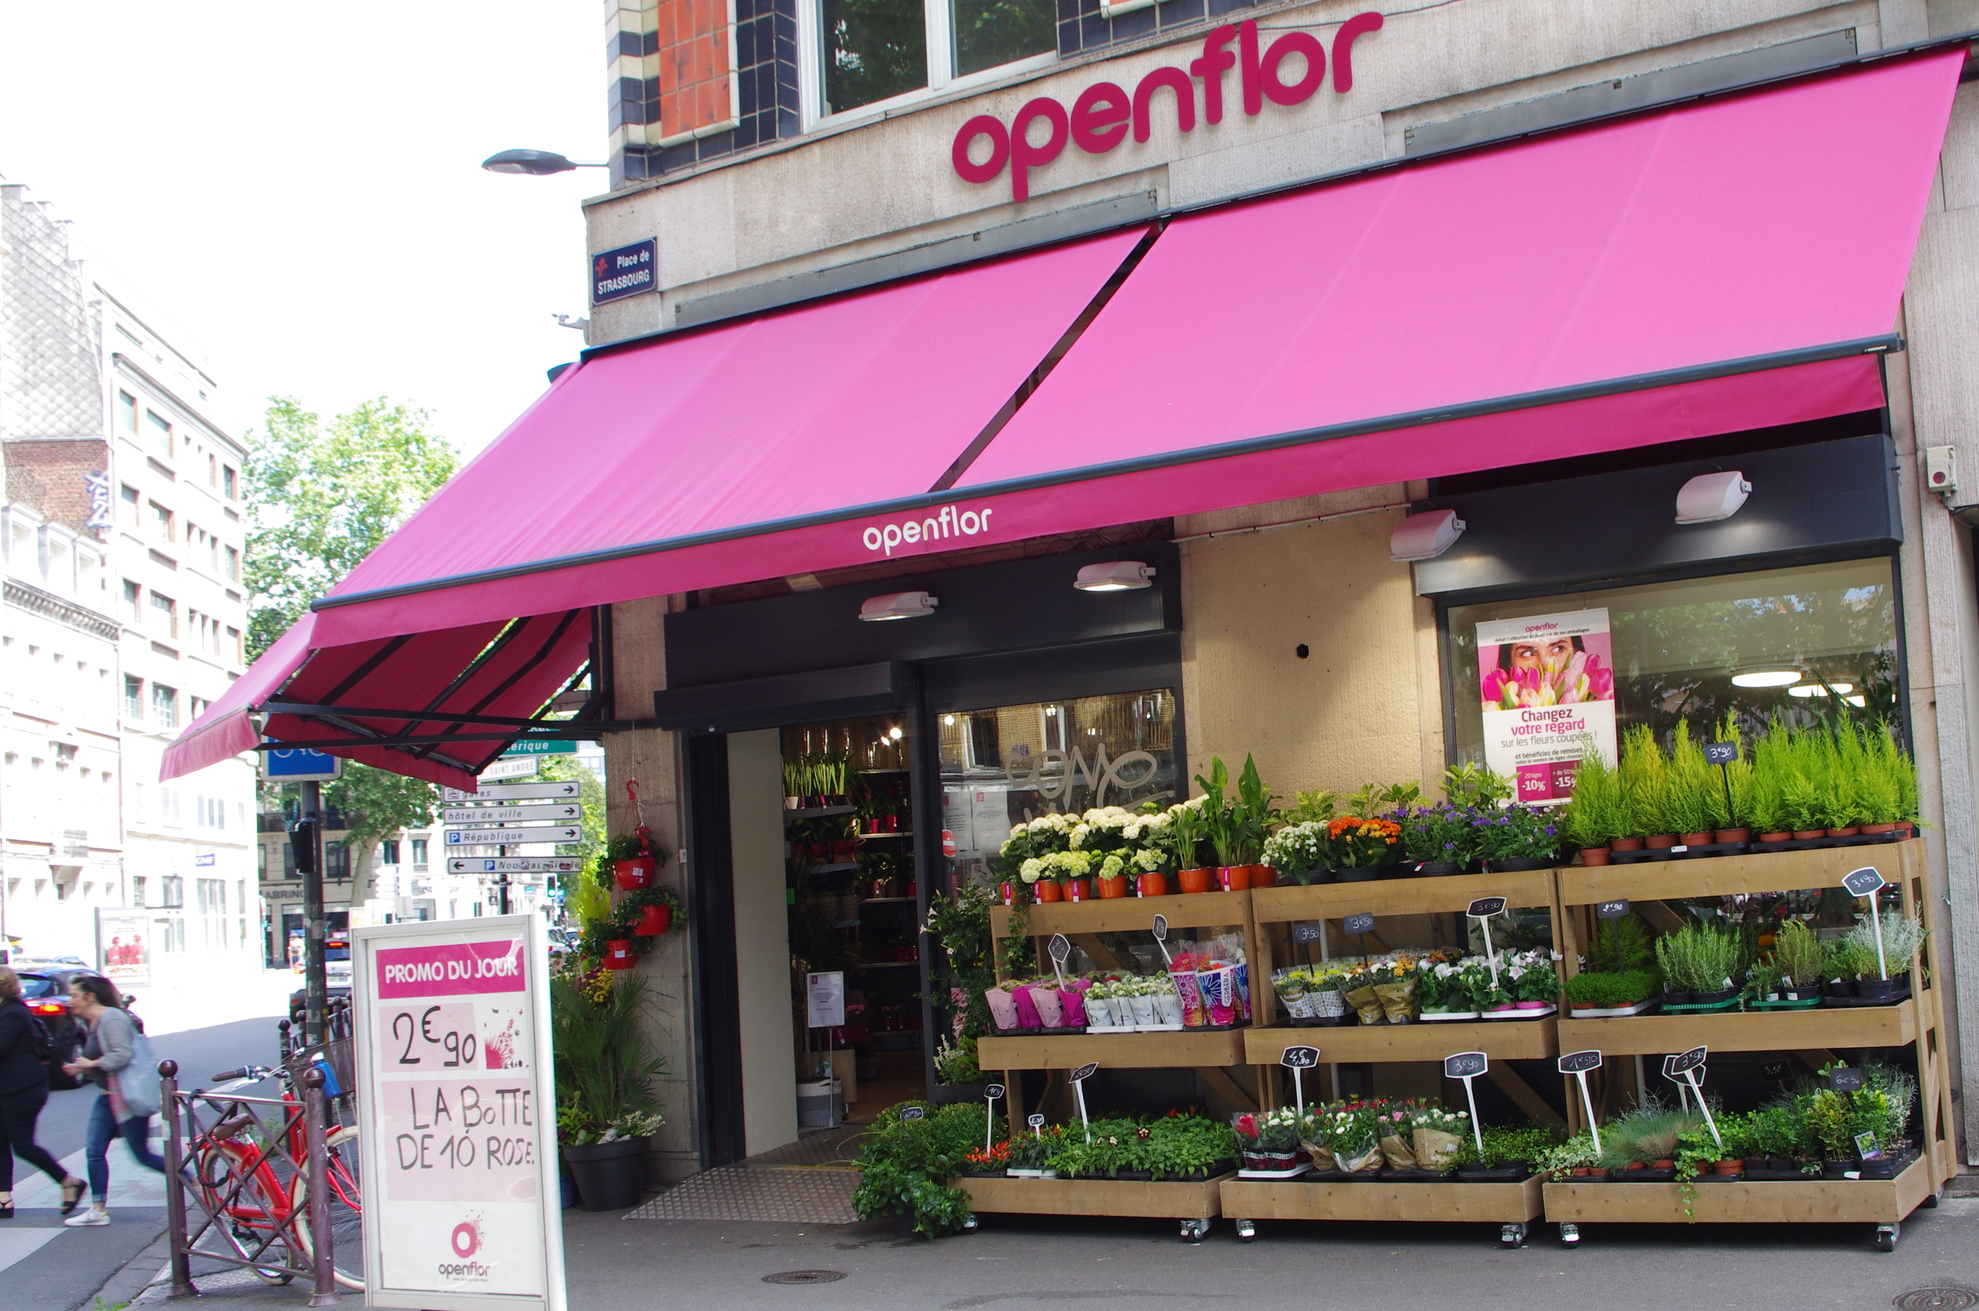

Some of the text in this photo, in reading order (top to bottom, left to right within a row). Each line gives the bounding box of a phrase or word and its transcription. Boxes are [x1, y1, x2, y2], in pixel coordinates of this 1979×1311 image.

[951, 11, 1384, 203] openflor
[616, 249, 650, 269] Place de
[597, 268, 650, 295] STRASBOURG
[862, 504, 993, 556] openflor
[1525, 622, 1558, 632] openflor
[1567, 627, 1590, 636] emballages
[1521, 708, 1573, 722] Changez
[1511, 717, 1585, 736] votre regard
[1500, 740, 1514, 748] sur
[1516, 737, 1528, 747] les
[1530, 735, 1554, 746] fleurs
[1556, 730, 1593, 744] coupées
[1522, 750, 1550, 759] bénéficiez
[490, 760, 534, 776] SAINT ANDRÉ
[1532, 772, 1542, 780] tiges
[448, 810, 522, 820] hôtel de ville
[464, 832, 523, 842] République
[386, 957, 518, 984] PROMO DU JOUR
[411, 1087, 452, 1130] LA
[396, 1133, 534, 1170] DE 10 ROSE
[438, 1261, 491, 1280] openflor
